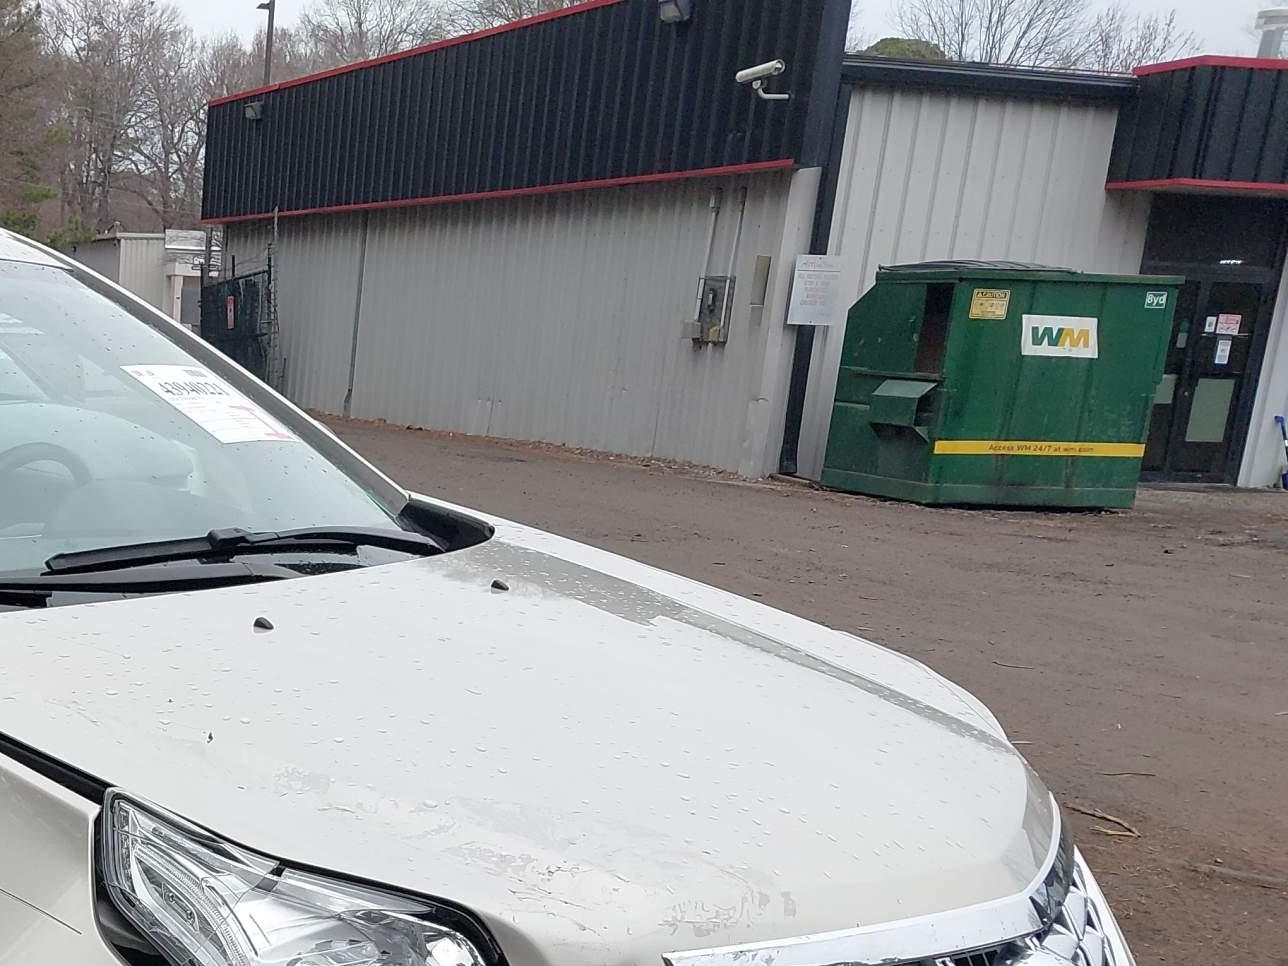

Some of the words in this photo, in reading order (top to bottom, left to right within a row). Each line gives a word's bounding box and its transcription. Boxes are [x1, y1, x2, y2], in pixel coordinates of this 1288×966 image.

[1031, 325, 1090, 349] WM
[157, 381, 231, 397] 43940221
[1016, 444, 1032, 452] WM
[1033, 445, 1052, 453] 24/7
